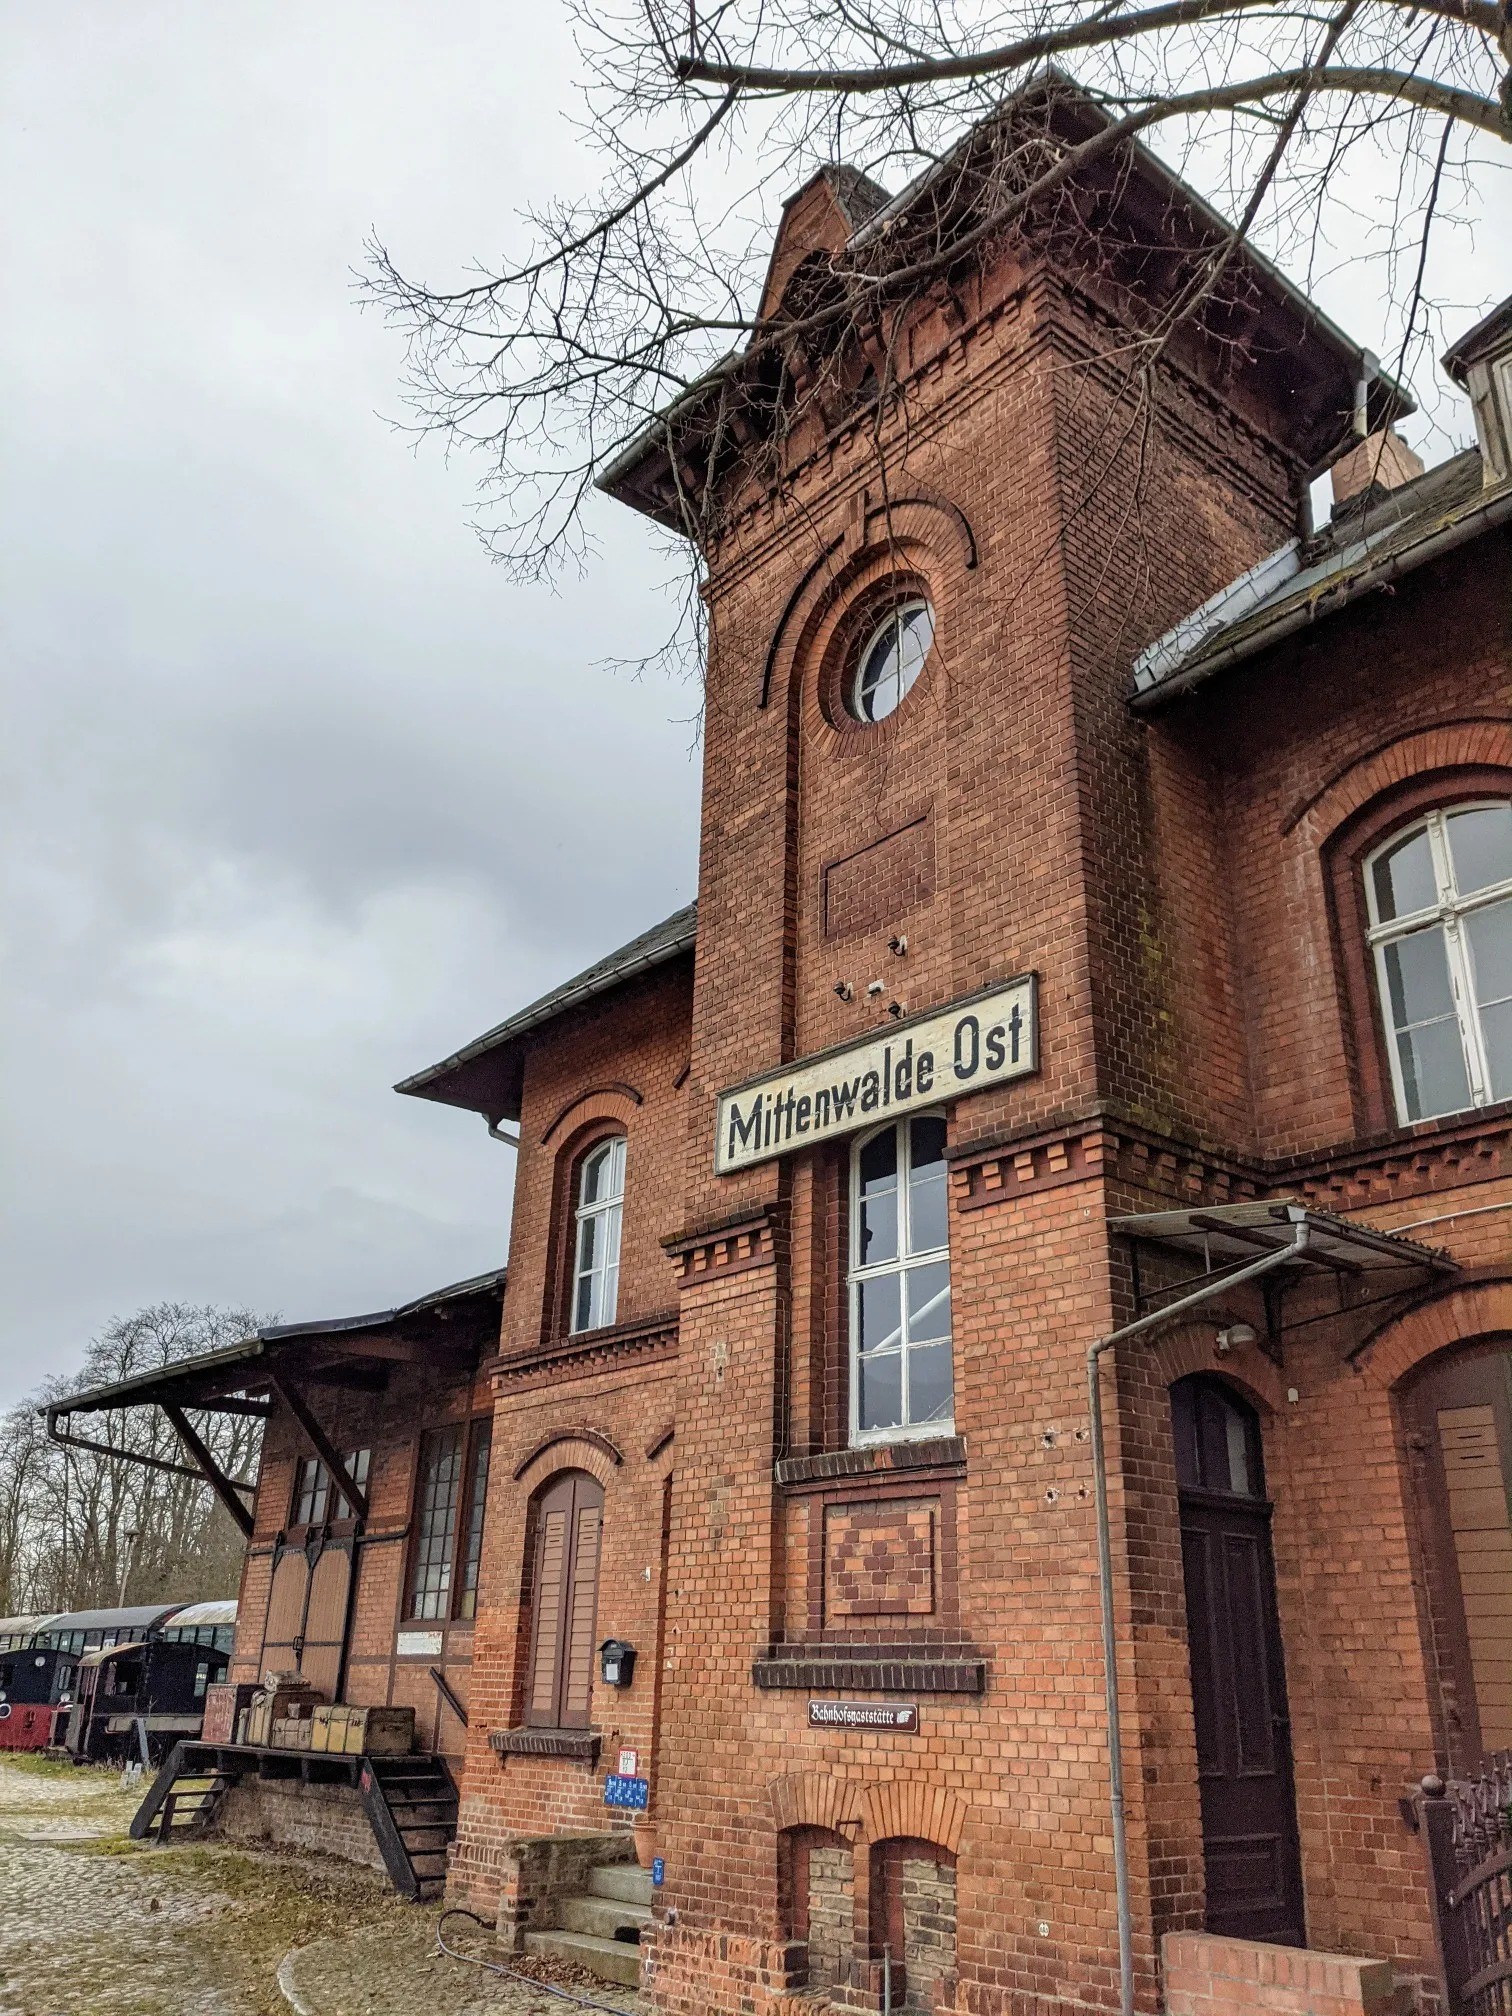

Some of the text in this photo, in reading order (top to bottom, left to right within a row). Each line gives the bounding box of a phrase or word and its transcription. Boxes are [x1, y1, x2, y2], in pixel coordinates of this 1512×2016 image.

[727, 1002, 1024, 1160] Mittenwalde Ost
[810, 1703, 894, 1726] Bahnhofsgaststätte
